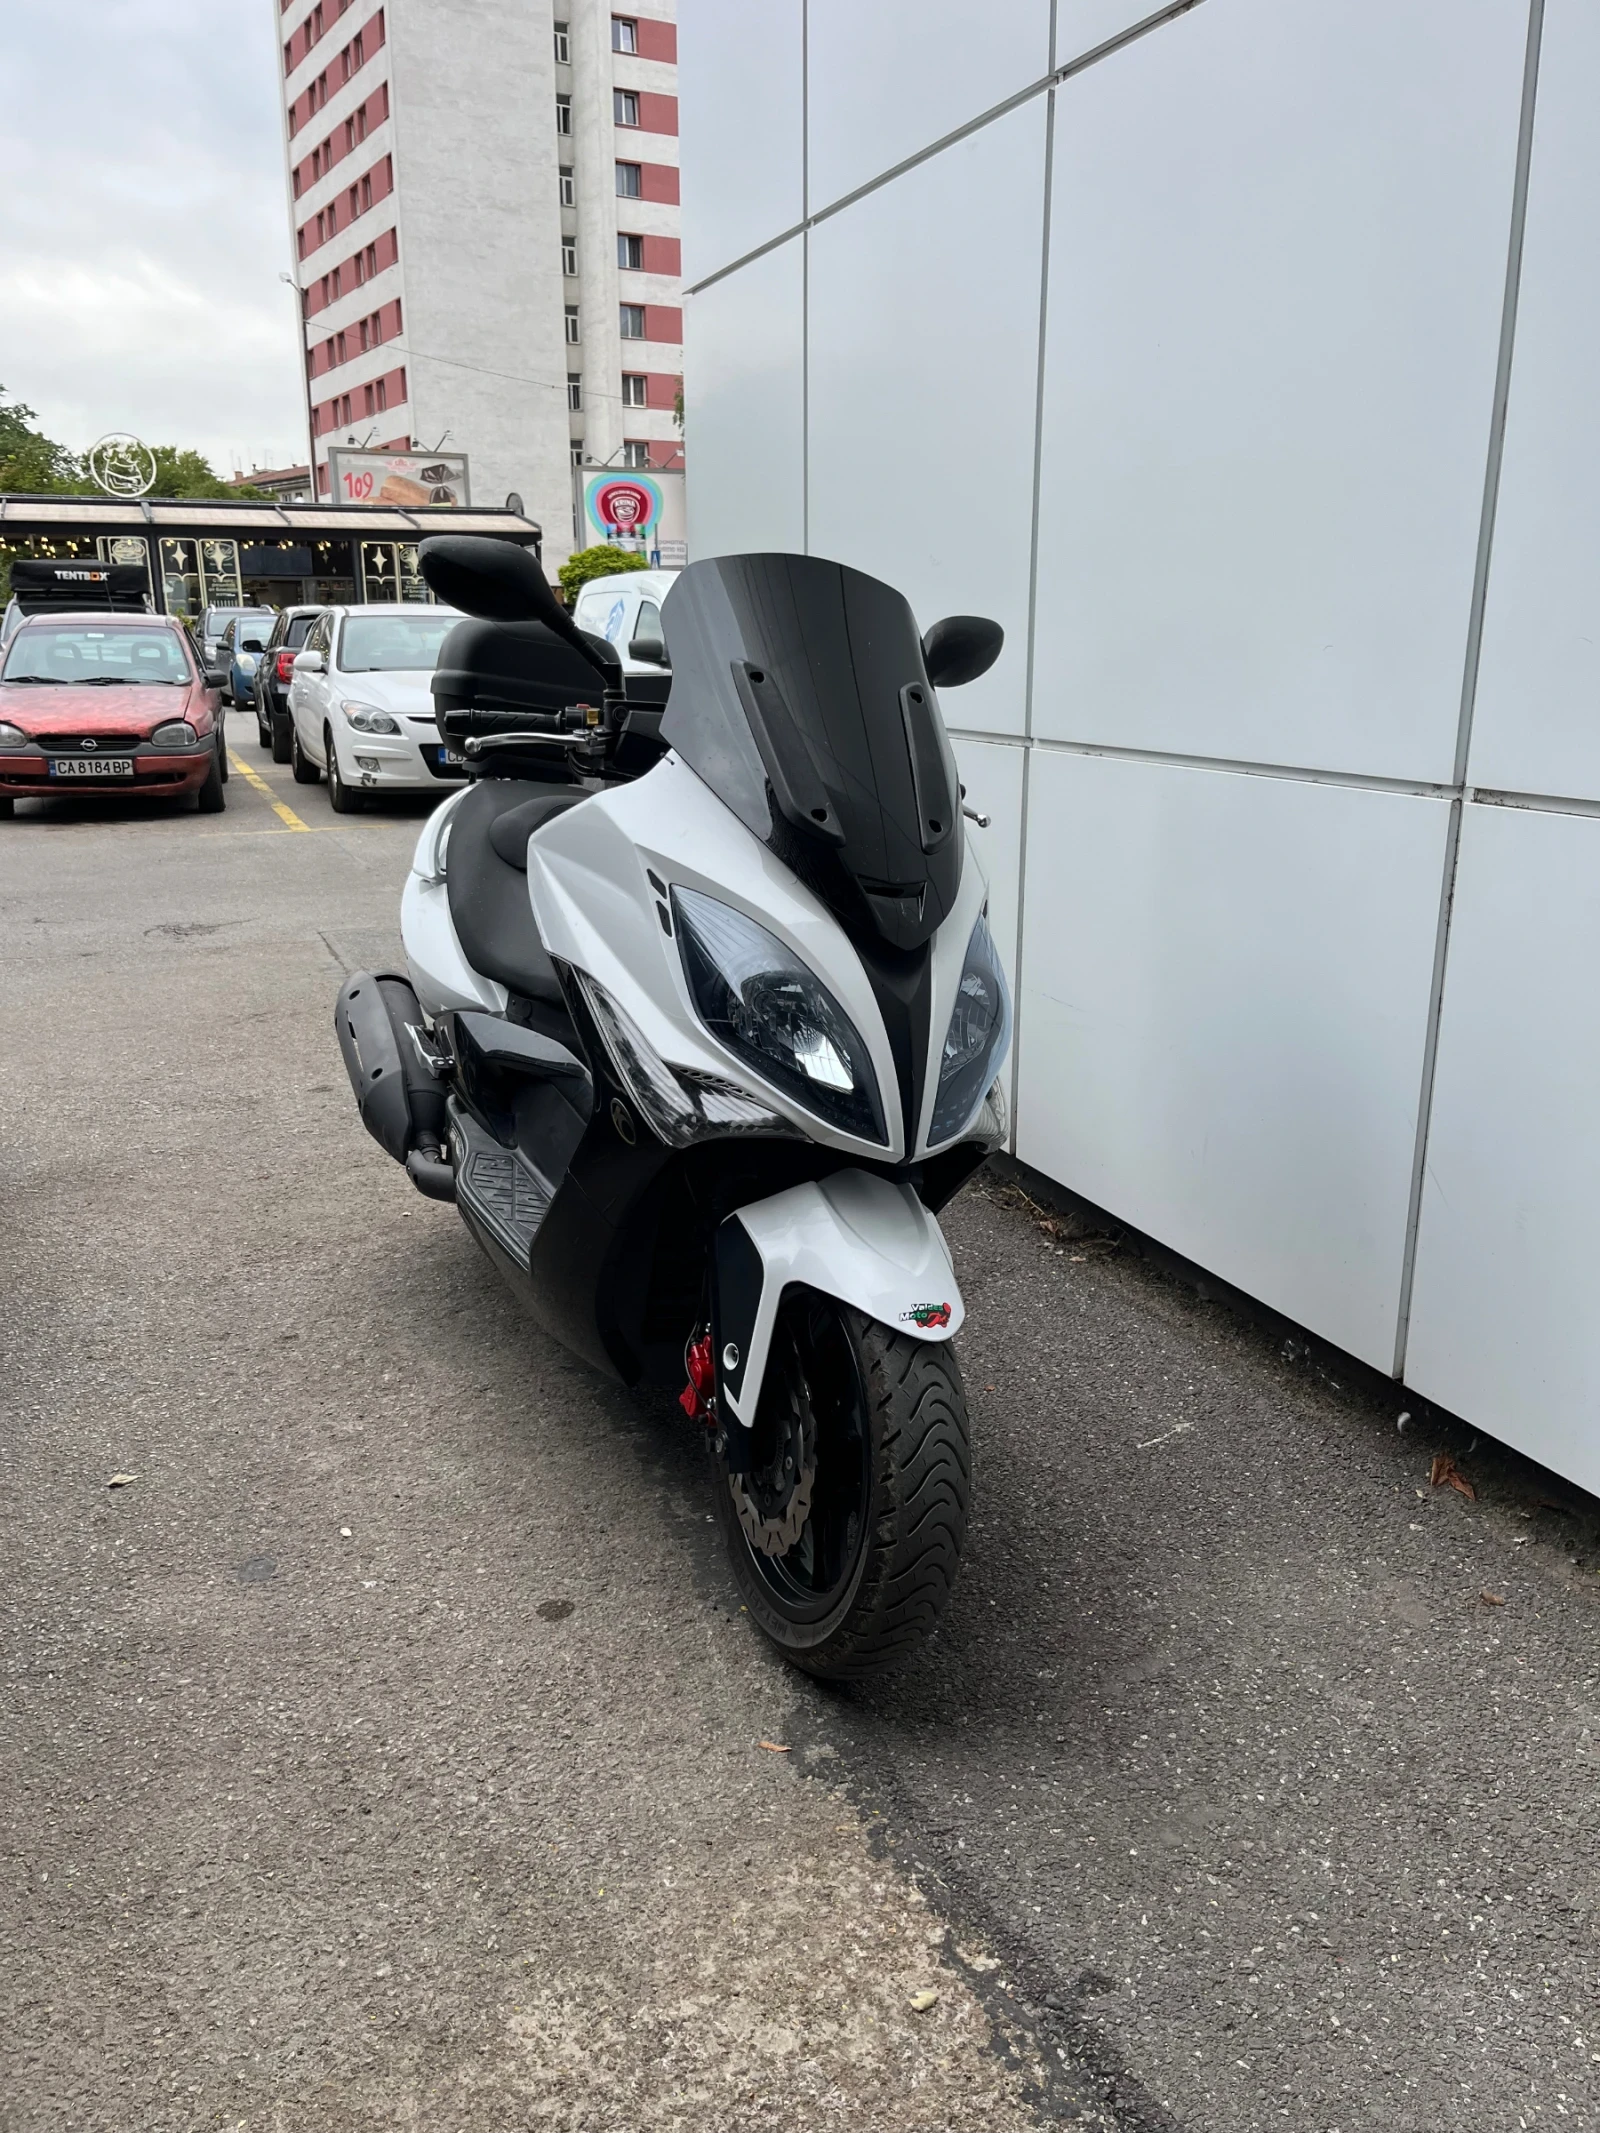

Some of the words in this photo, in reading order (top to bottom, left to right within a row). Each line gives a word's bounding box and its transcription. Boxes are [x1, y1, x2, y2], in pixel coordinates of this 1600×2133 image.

[343, 471, 373, 499] 109
[54, 570, 109, 581] TENTBOX
[57, 761, 75, 774] CA
[78, 761, 110, 774] 8184
[113, 761, 130, 774] BP
[911, 1303, 943, 1311] Valdes
[899, 1311, 927, 1321] Moto
